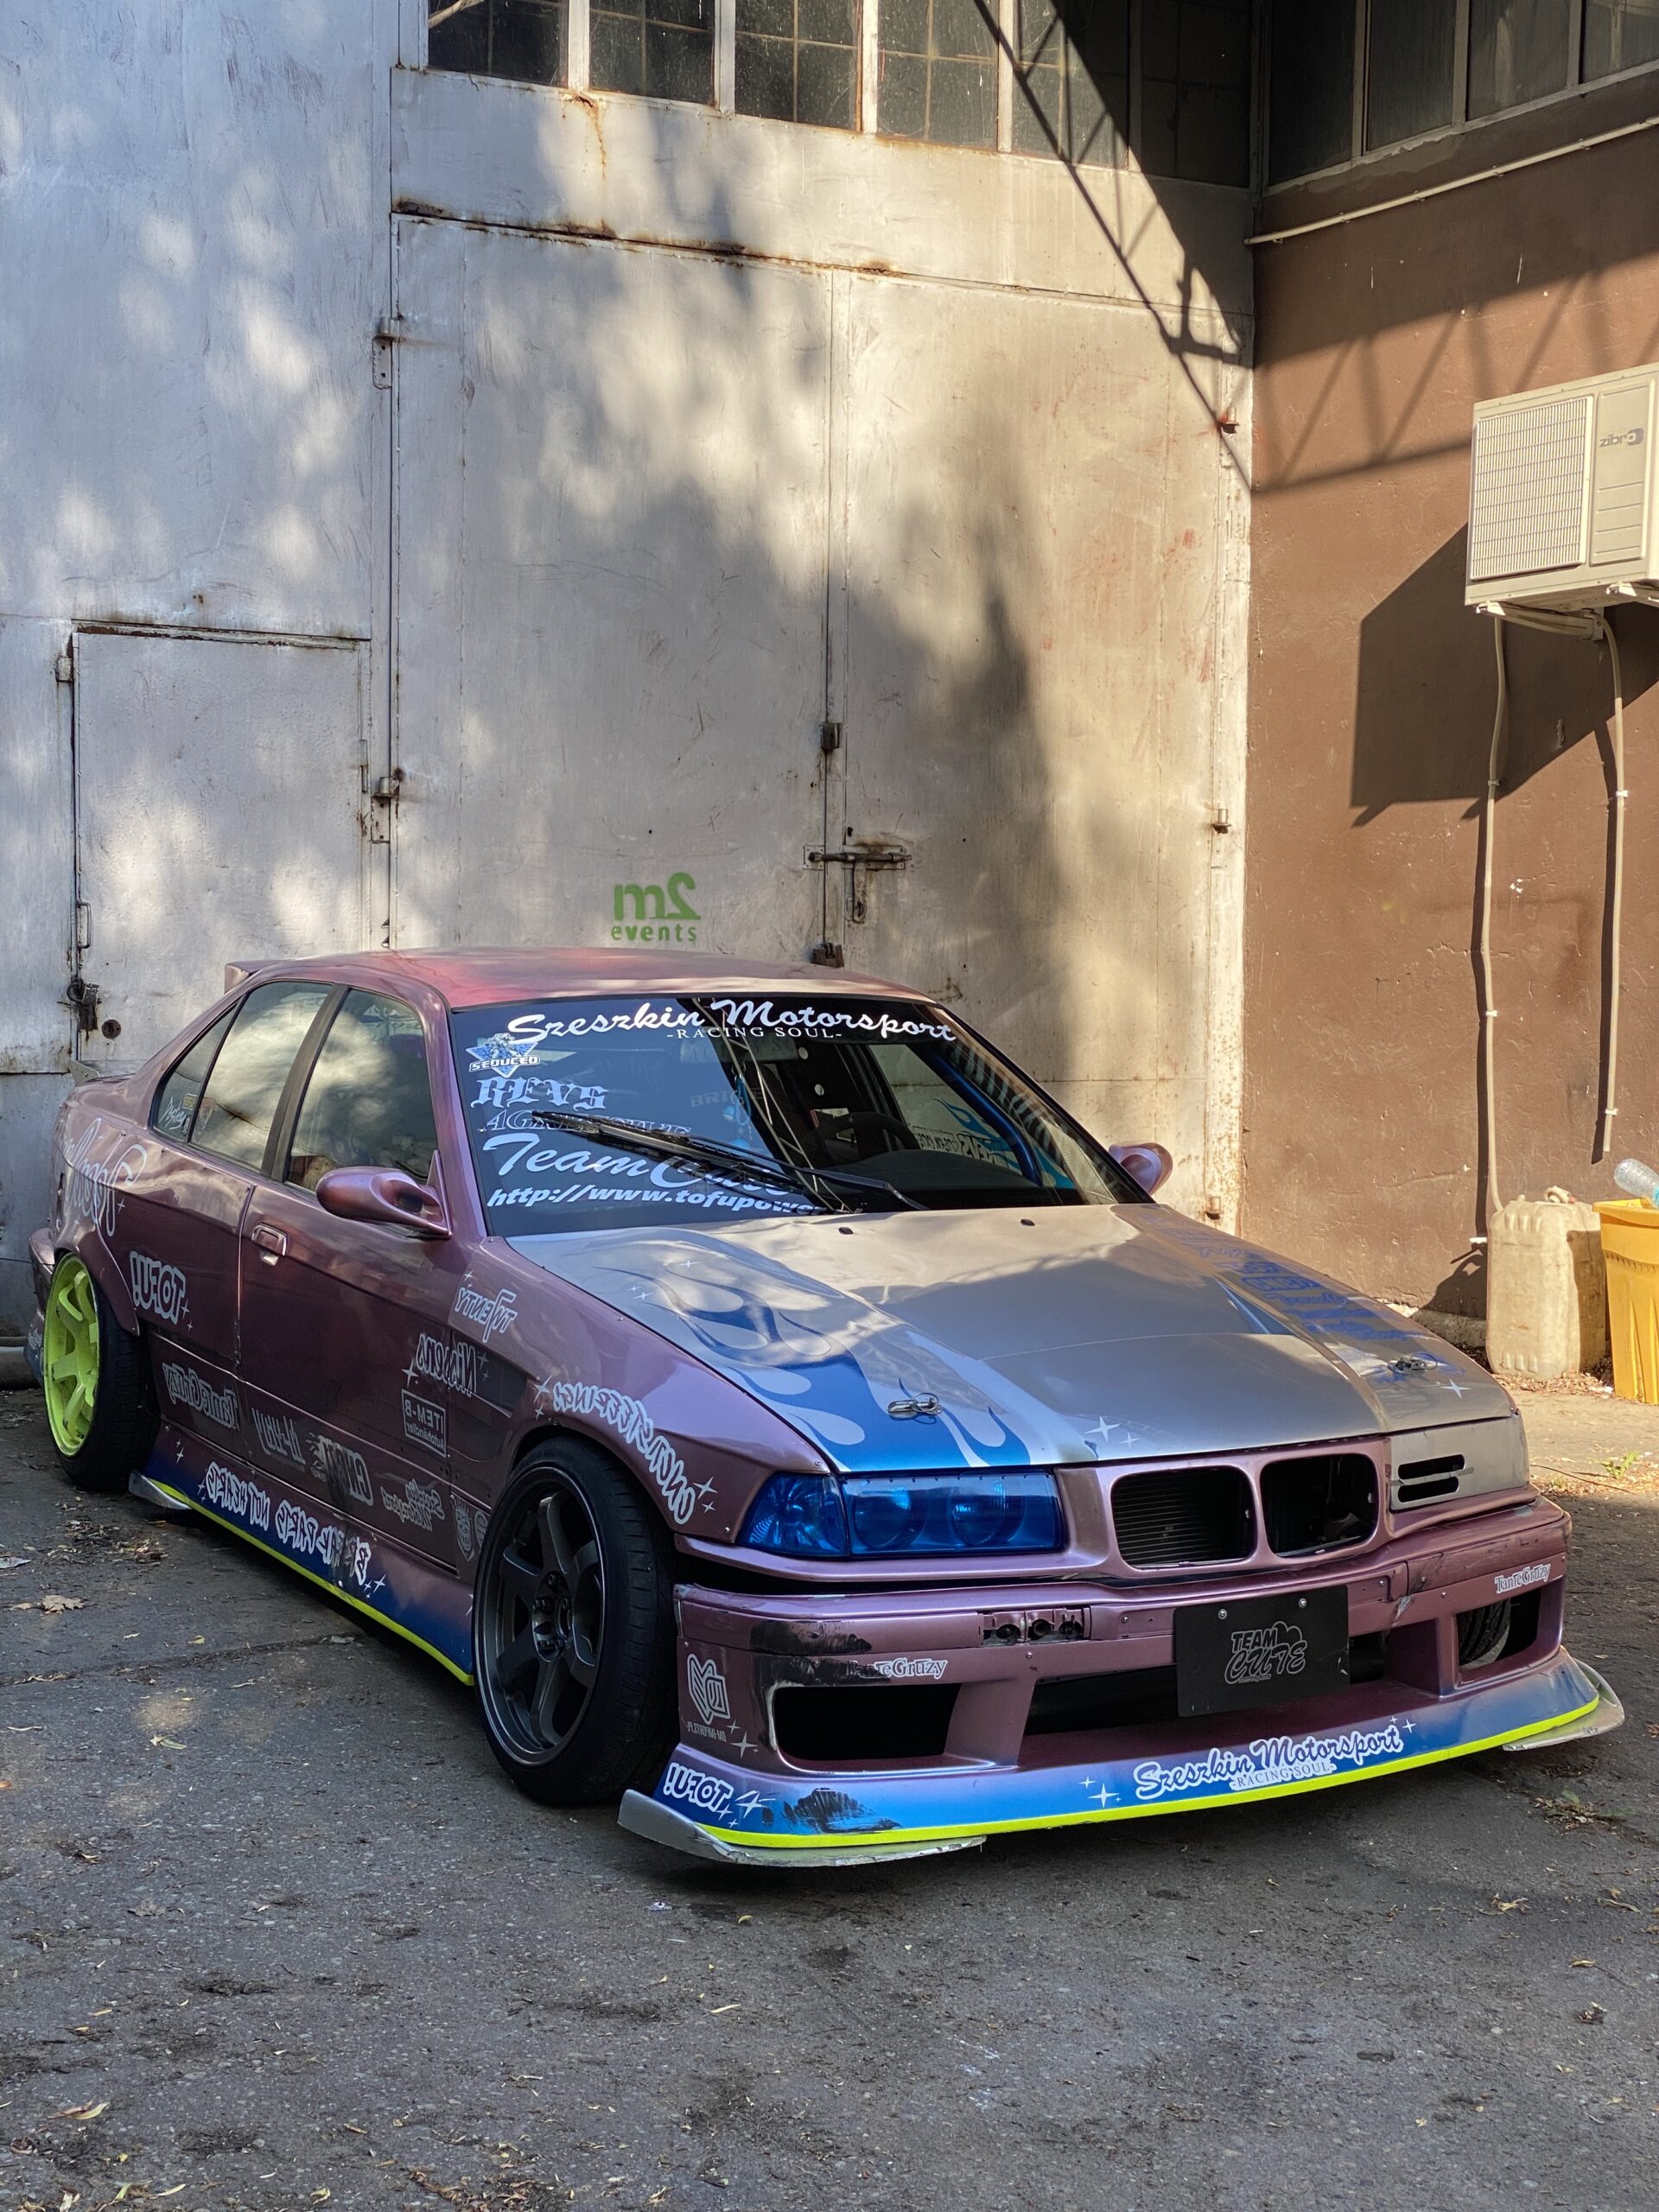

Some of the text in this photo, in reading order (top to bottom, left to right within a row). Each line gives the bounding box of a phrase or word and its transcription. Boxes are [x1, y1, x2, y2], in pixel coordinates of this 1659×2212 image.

[611, 924, 696, 942] events
[506, 998, 957, 1044] Szeszkin Motorsport
[471, 1056, 538, 1071] SEDUCED
[470, 1077, 609, 1111] REVS
[482, 1132, 650, 1177] Team
[1230, 1627, 1278, 1654] TEAM
[1224, 1640, 1307, 1685] CUTE
[1133, 1724, 1404, 1800] Szeszkin Motorsport
